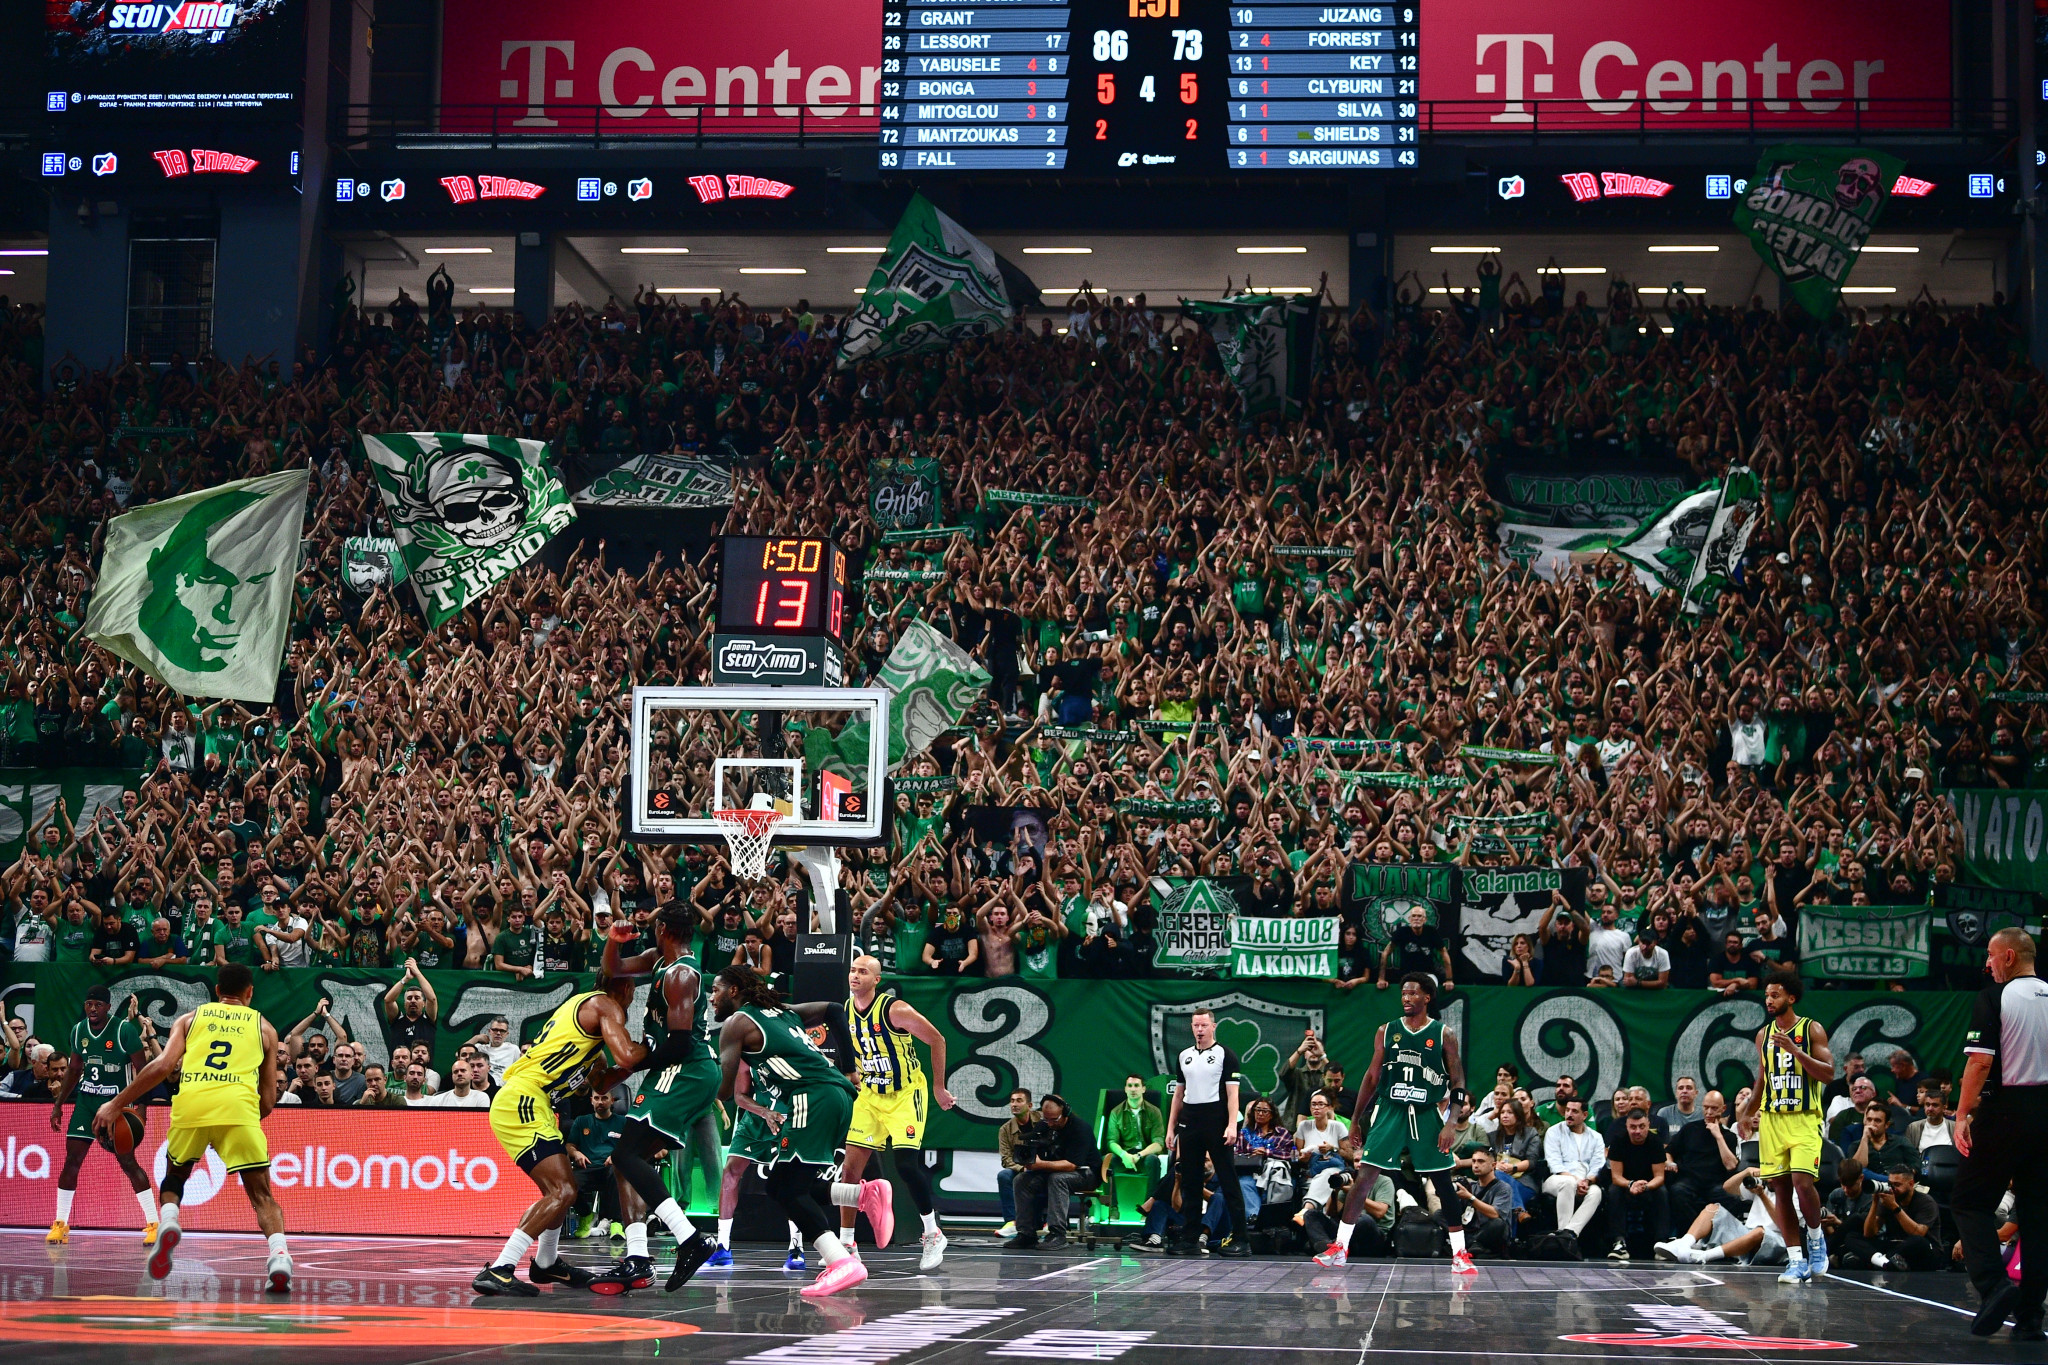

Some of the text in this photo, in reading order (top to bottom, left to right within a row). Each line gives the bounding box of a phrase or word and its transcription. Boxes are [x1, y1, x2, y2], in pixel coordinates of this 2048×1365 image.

[884, 12, 974, 26] 22 GRANT
[1237, 9, 1412, 23] 10 JUZANG 9
[884, 35, 1062, 49] 26 LESSORT 17
[1093, 30, 1202, 61] 86 73
[1240, 33, 1416, 47] 2 4 FORREST 11
[884, 58, 1058, 72] 28 YABUSELE 4 8
[1236, 56, 1416, 70] 13 1 KEY 12
[500, 40, 882, 126] T Center
[1476, 34, 1884, 122] T Center
[884, 82, 1036, 96] 32 BONGA 3
[1097, 73, 1198, 104] 5 4 5
[1239, 80, 1414, 94] 6 1 CLYBURN 21
[882, 105, 1056, 119] 44 MITOGLOU 3 8
[1240, 104, 1416, 118] 1 1 SILVA 30
[882, 128, 1056, 142] 72 MANTZOUKAS 2
[1095, 119, 1198, 140] 2 2
[1238, 127, 1414, 142] 6 1 SHIELDS 31
[151, 149, 188, 177] ΤΑ
[190, 149, 260, 174] ΣΠΑΕΙ
[882, 152, 1056, 166] 93 FALL 2
[1238, 150, 1414, 164] 3 1 SARGIUNAS 43
[438, 175, 547, 203] ΤΑ ΣΠΑΕΙ
[686, 175, 796, 203] ΤΑ ΣΠΑΕΙ
[1559, 171, 1675, 202] ΤΑ ΣΠΑΕΙ
[1890, 175, 1938, 197] ΑΕΙ
[990, 490, 1039, 503] ΜΕΓΑΡΑ
[1507, 474, 1684, 505] VIRONAS
[344, 536, 401, 552] KALYMN
[423, 506, 576, 612] TINOS
[762, 540, 822, 573] 1:50
[414, 555, 476, 585] GATE 13
[756, 580, 809, 627] 13
[1462, 868, 1562, 902] Kalamata
[1801, 915, 1929, 955] MESSINI
[804, 947, 837, 955] SPALDING
[1236, 953, 1331, 976] ΛΑΚΩΝΙΑ
[1826, 957, 1906, 974] GATE 13
[203, 1009, 253, 1022] BALDWIN IV
[219, 1024, 245, 1035] MSC
[860, 1037, 877, 1052] 31
[204, 1040, 233, 1070] 2
[1776, 1052, 1793, 1069] 12
[91, 1067, 99, 1081] 3
[1403, 1067, 1414, 1082] 11
[1770, 1071, 1803, 1090] tarfin
[0, 1136, 500, 1189] la ellomoto
